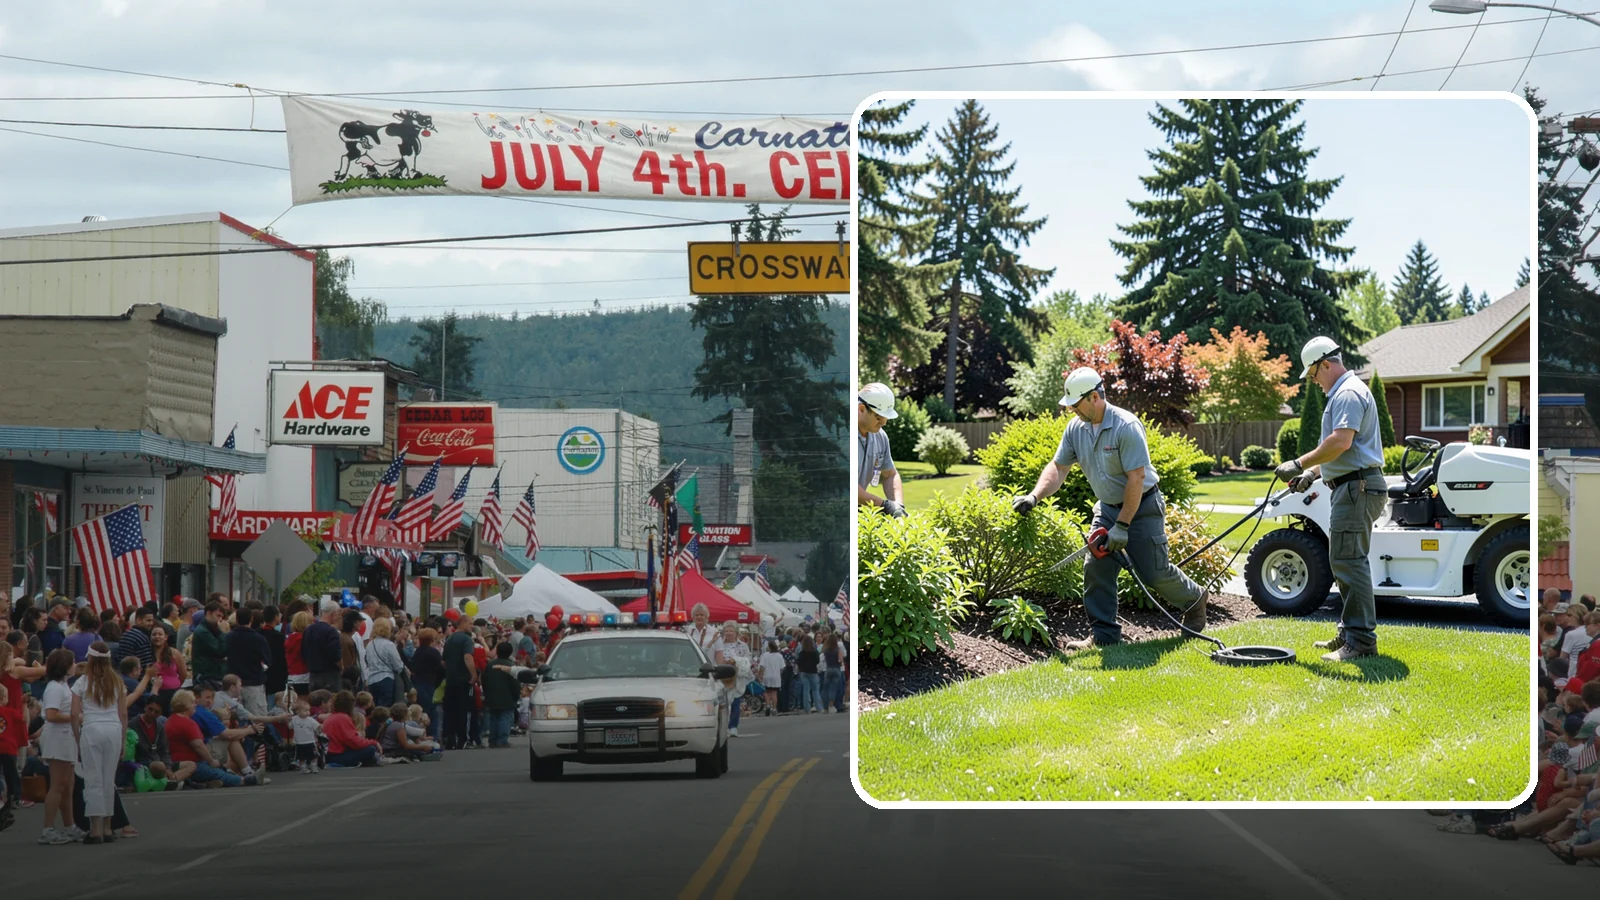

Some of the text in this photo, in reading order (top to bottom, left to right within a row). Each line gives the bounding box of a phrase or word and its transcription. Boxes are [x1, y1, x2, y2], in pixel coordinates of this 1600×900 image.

[481, 140, 605, 193] JULY
[632, 150, 747, 198] 4th.
[697, 254, 850, 280] CROSSWA
[282, 380, 374, 420] ACE
[283, 420, 371, 437] Hardware
[416, 428, 477, 447] Coca-Cola
[353, 467, 384, 478] Simpl
[95, 485, 124, 495] Vincent
[126, 485, 136, 495] de
[137, 485, 155, 495] Paul
[81, 503, 154, 523] THT
[212, 514, 331, 536] HARDARE
[688, 526, 741, 535] CRNATION
[699, 535, 730, 543] GLASS
